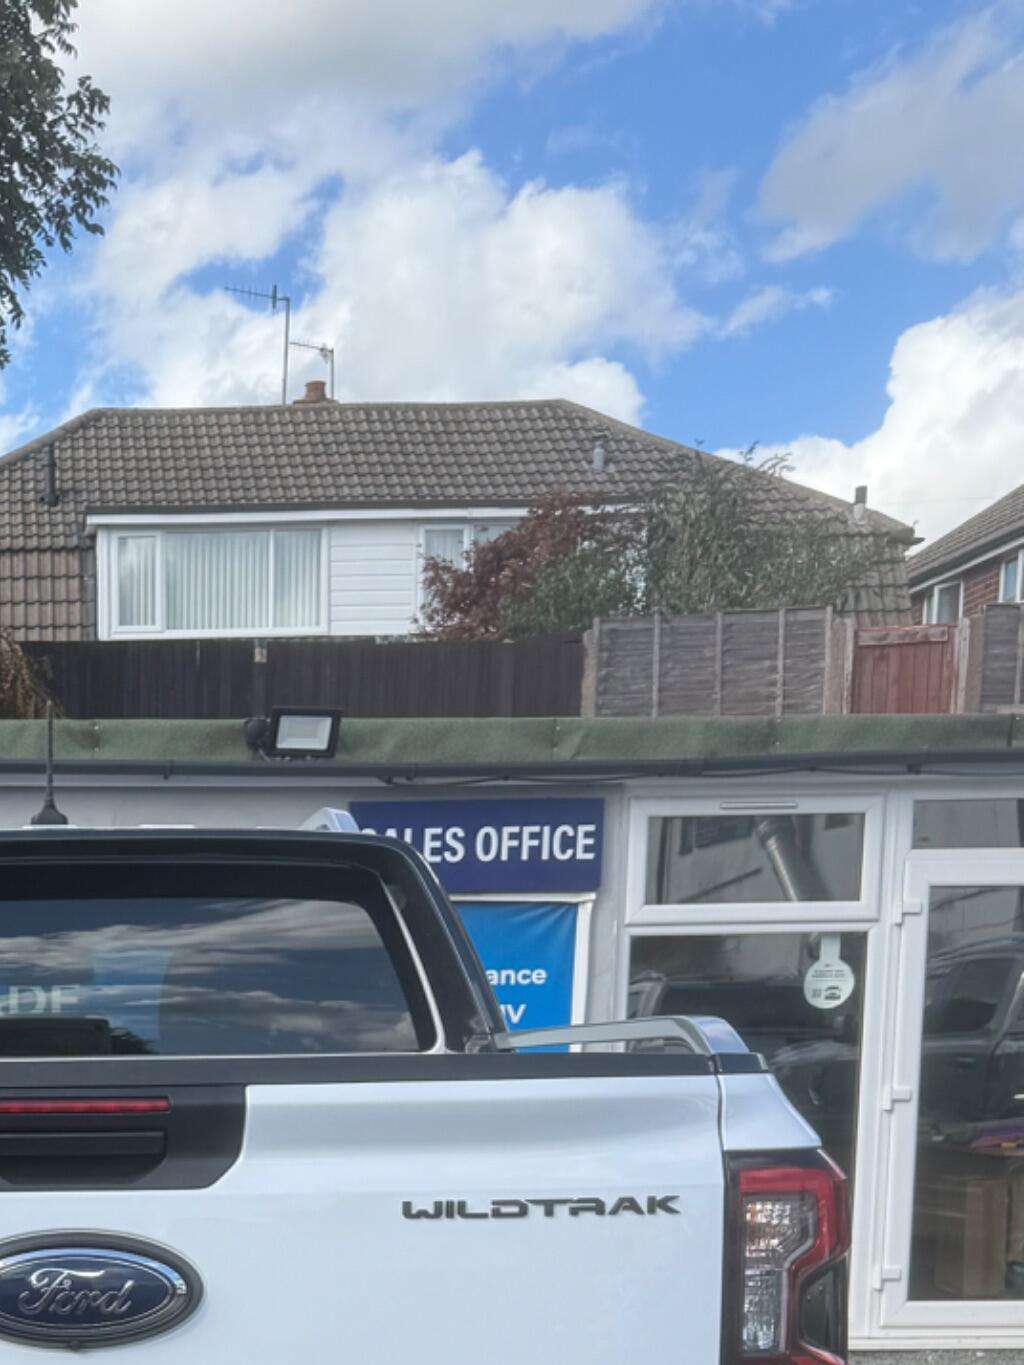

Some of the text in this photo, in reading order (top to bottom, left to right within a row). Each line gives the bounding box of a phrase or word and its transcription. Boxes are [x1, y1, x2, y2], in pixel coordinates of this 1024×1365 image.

[475, 824, 596, 862] OFFICE
[485, 967, 547, 986] ance
[401, 1195, 681, 1220] WILDTRAK
[17, 1266, 134, 1316] Ford
